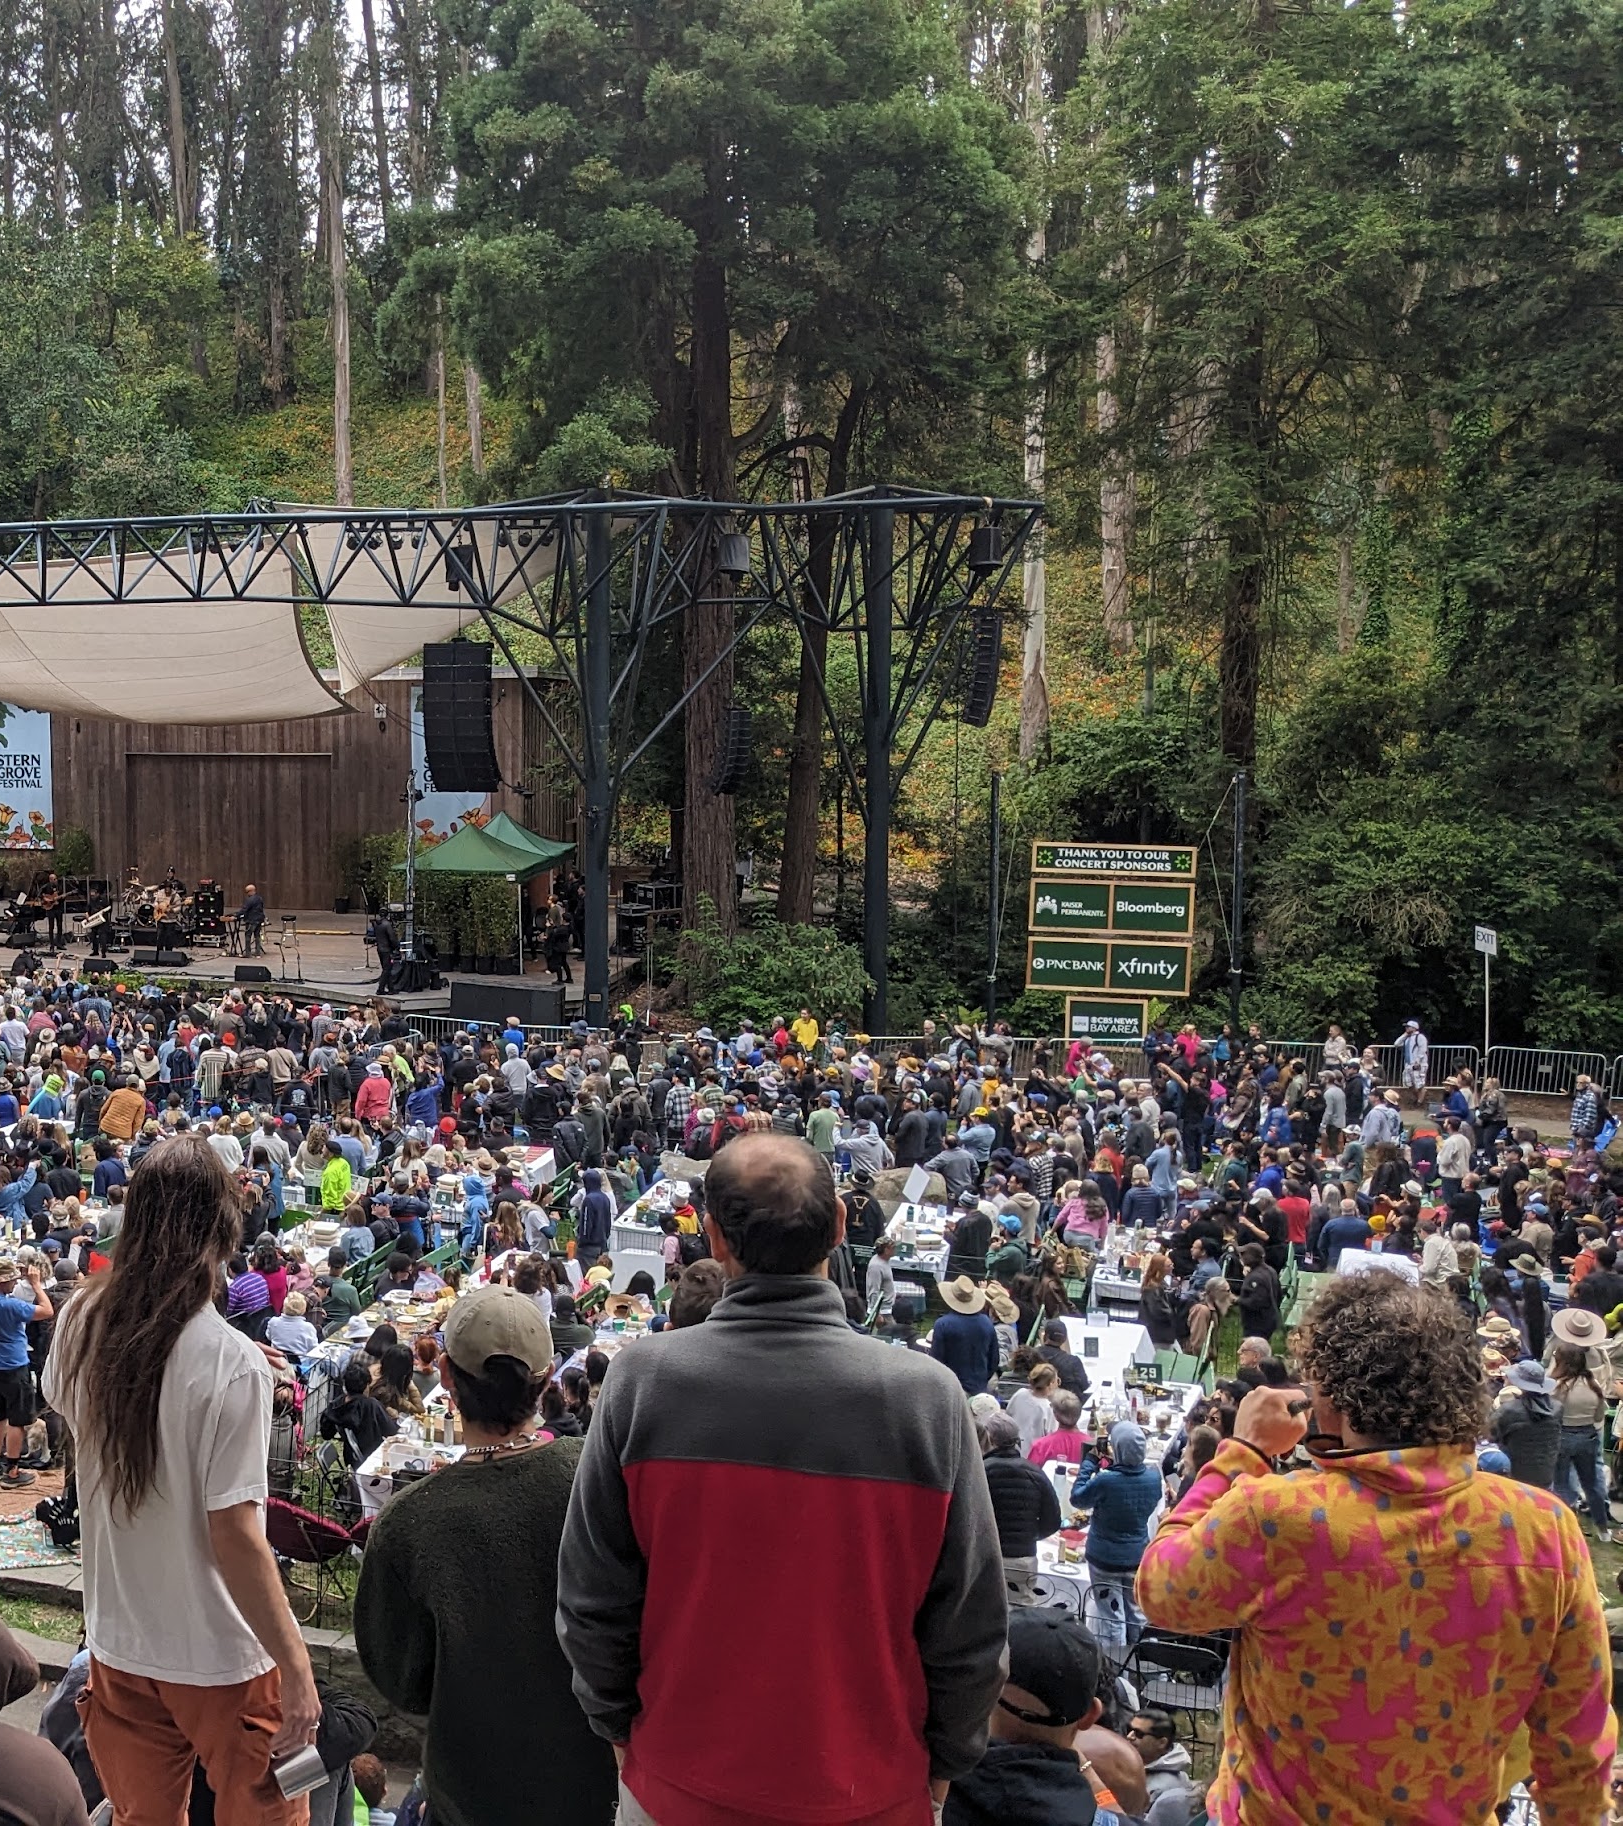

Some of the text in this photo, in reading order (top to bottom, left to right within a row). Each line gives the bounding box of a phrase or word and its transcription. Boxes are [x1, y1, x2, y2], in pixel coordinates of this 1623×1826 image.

[1057, 847, 1170, 861] THANK YOU TO OUR
[1054, 858, 1172, 872] CONCERT SPONSORS
[1061, 901, 1083, 910] KAISER
[1115, 900, 1185, 917] Bloomberg
[1476, 930, 1496, 945] EXIT
[1046, 958, 1105, 971] PNC BANK
[1117, 957, 1179, 980] xfinity
[1097, 1016, 1139, 1025] CBS NEWS
[1090, 1023, 1140, 1034] BAY AREA
[901, 1244, 908, 1253] 3
[1139, 1367, 1157, 1379] 29
